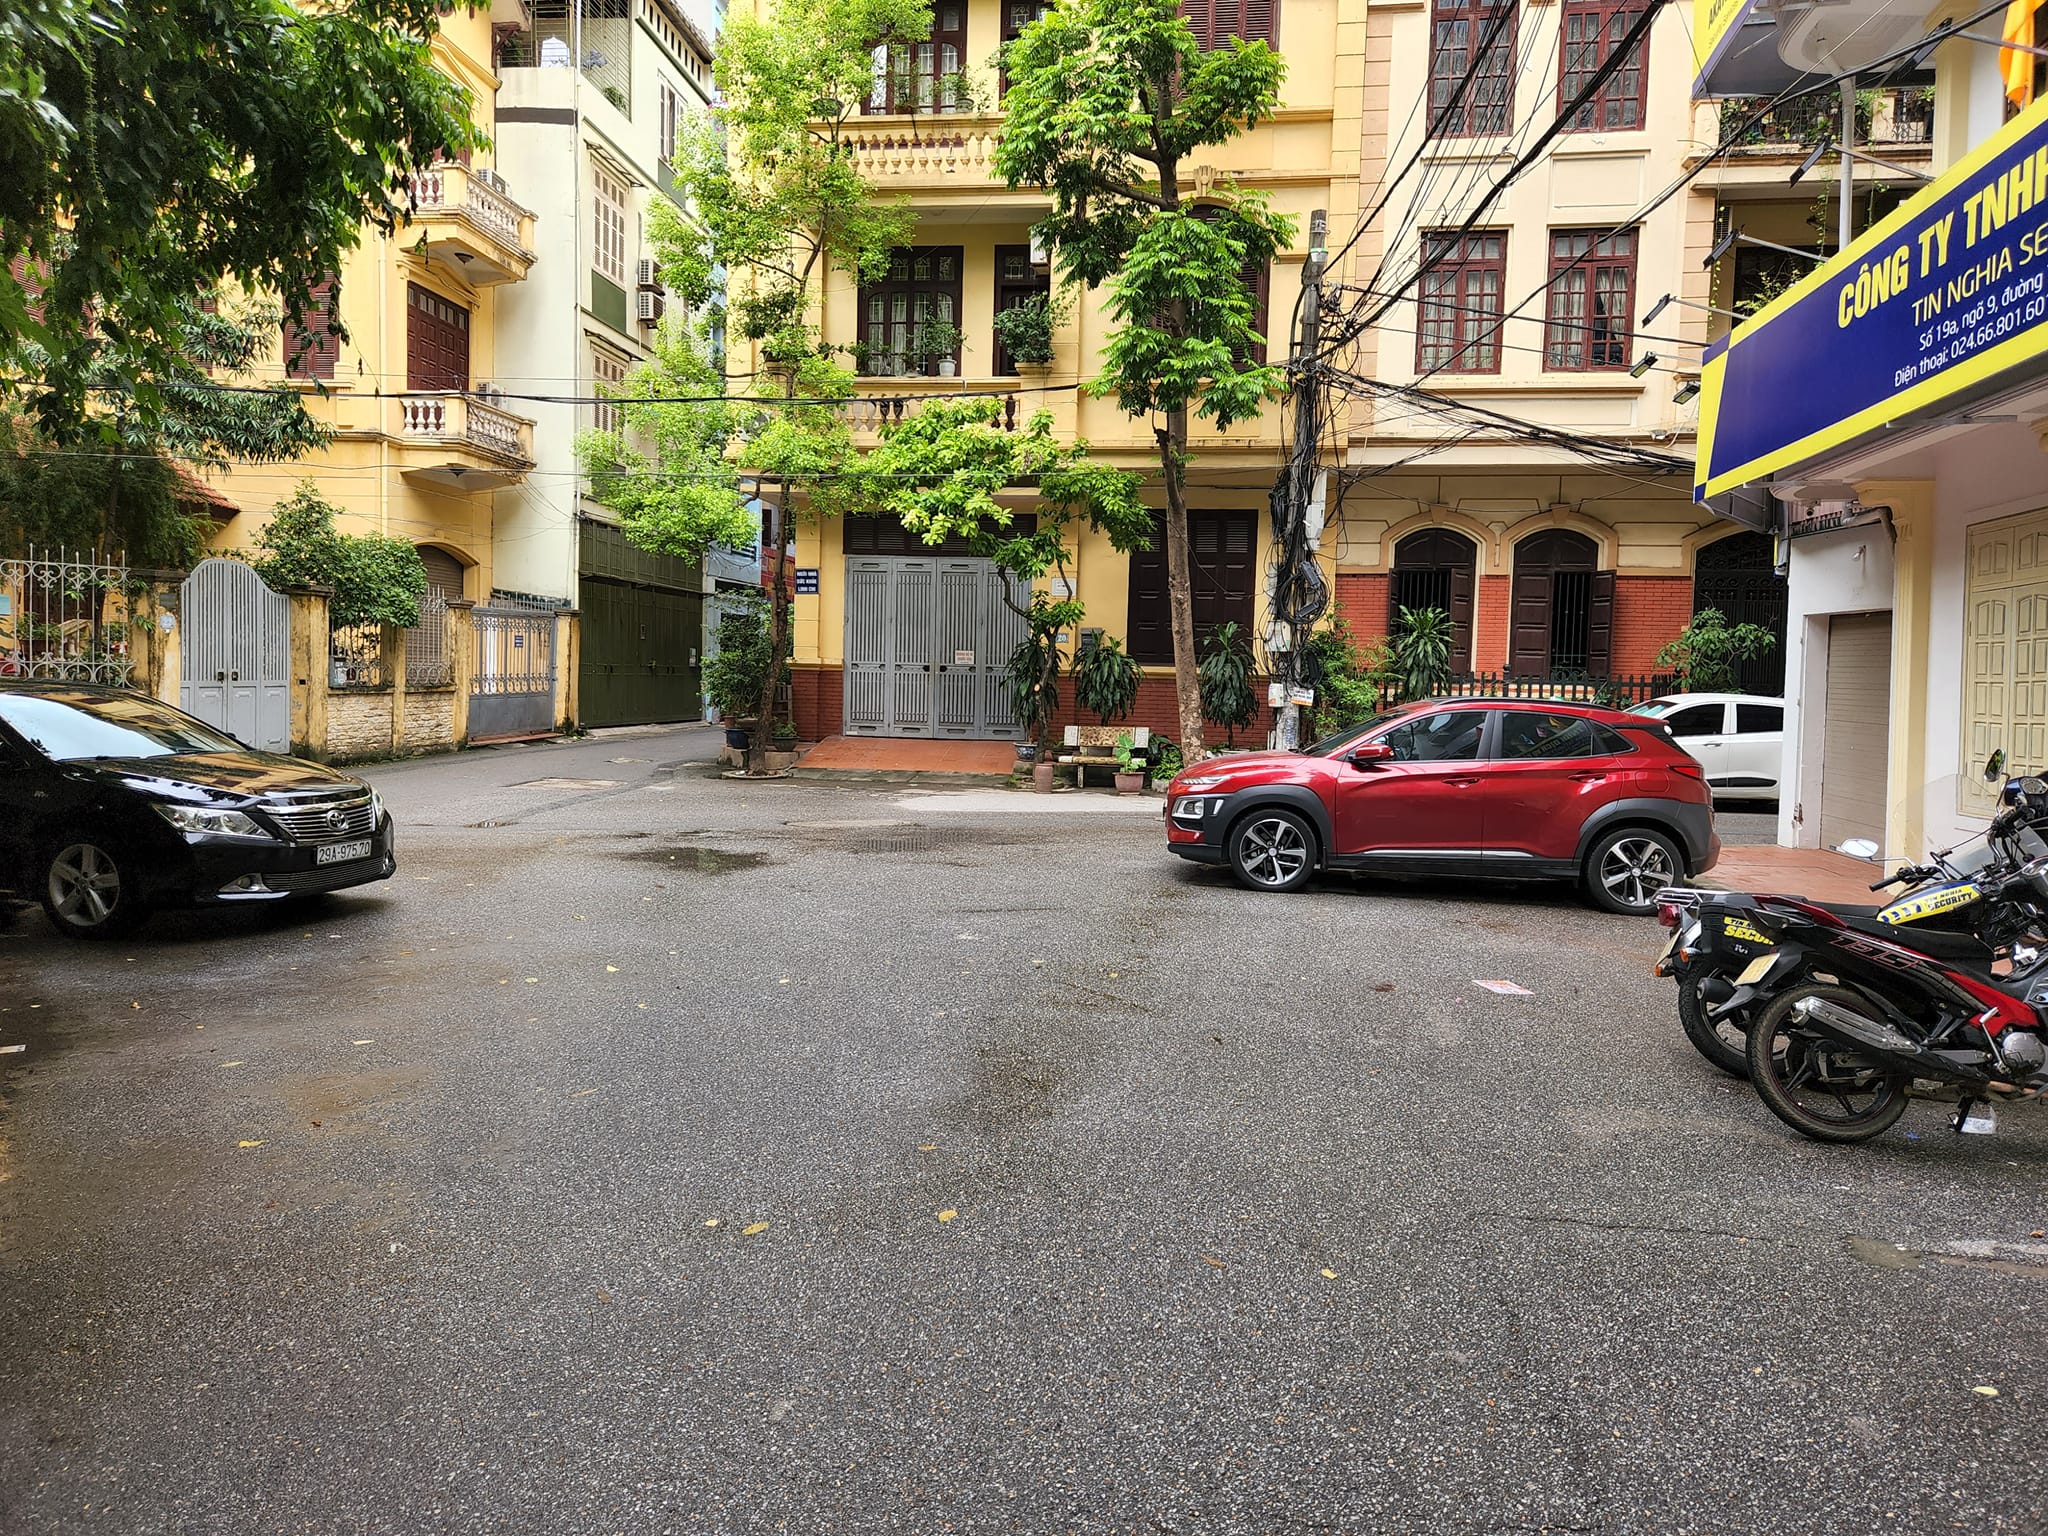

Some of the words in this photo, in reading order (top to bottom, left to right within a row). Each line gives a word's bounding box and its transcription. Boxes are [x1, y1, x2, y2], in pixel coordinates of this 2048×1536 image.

[1837, 244, 1910, 329] CÔNG
[1918, 211, 1954, 278] TY
[1911, 287, 1942, 327] TIN
[1947, 247, 2013, 309] NGHIA
[1894, 359, 1917, 388] Điện
[1919, 348, 1949, 374] thoại:
[1950, 292, 2048, 360] 024.66.801.60
[1918, 326, 1934, 351] Số
[1937, 319, 1960, 341] 19a,
[1961, 302, 1984, 330] ngõ
[2001, 272, 2044, 307] đường
[319, 841, 370, 863] 29A-975.70
[1724, 925, 1774, 945] SECU
[1928, 892, 1973, 911] SECURITY
